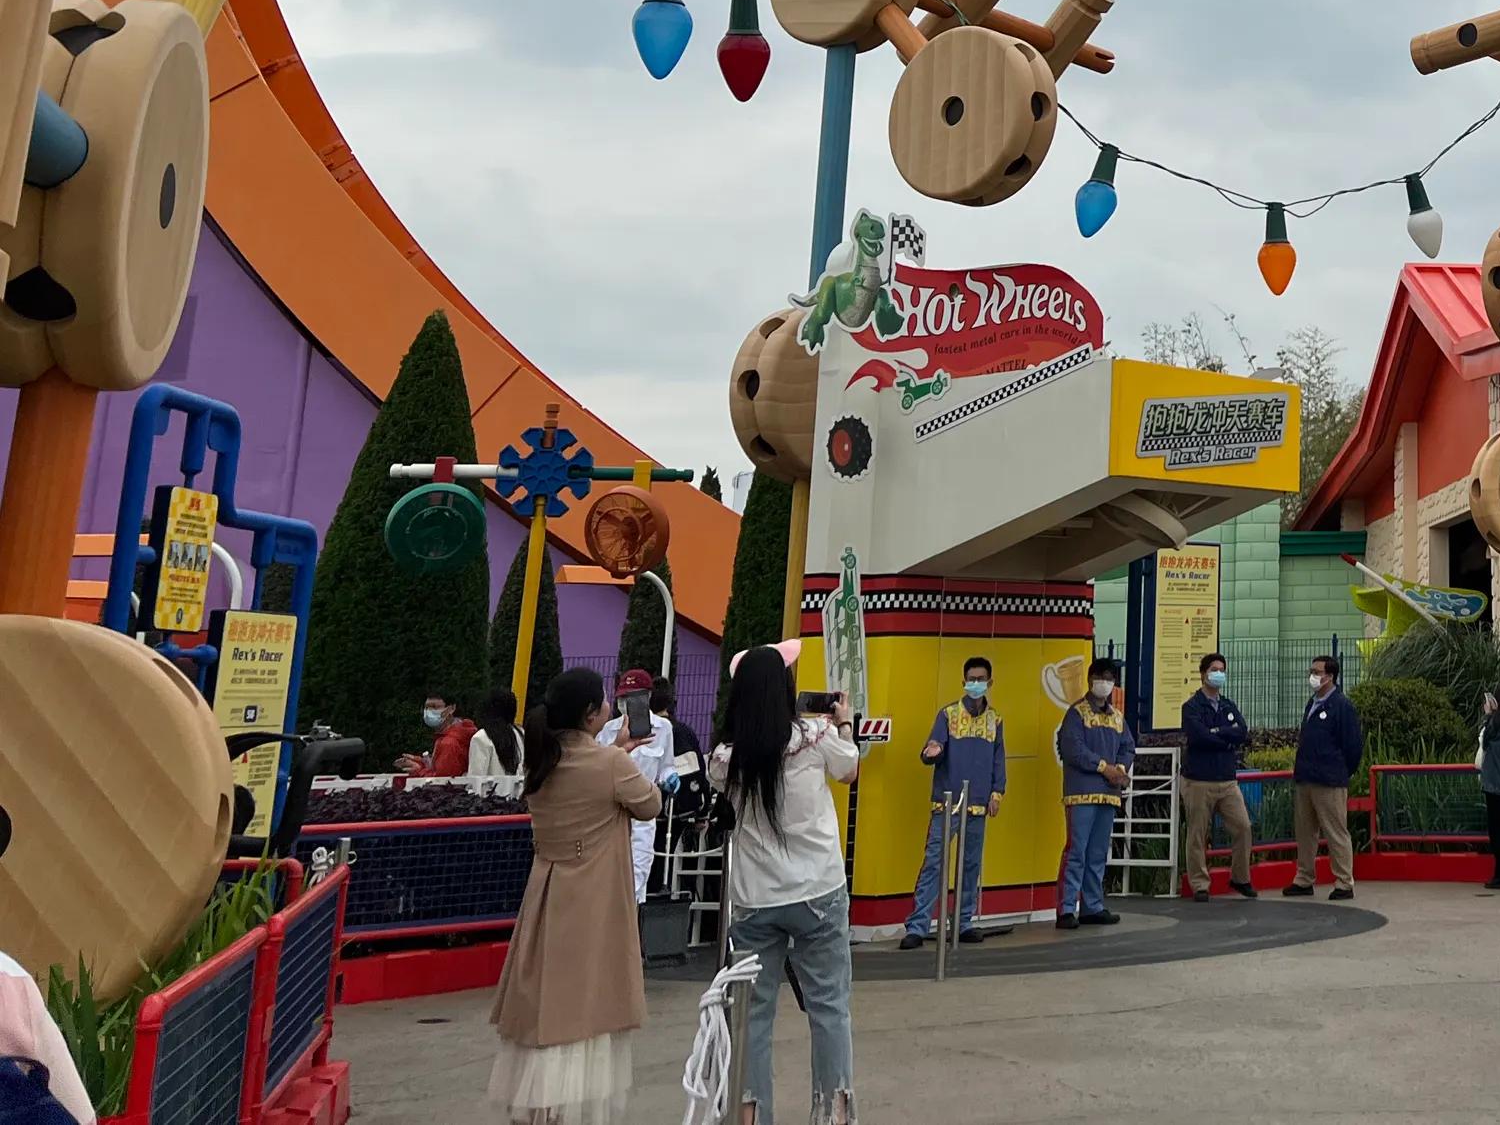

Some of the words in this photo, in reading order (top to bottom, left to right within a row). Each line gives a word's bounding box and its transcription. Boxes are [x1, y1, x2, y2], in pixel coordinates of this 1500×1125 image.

[890, 282, 967, 338] Hot
[965, 271, 1087, 333] Wheels
[934, 343, 967, 355] fastest
[970, 332, 997, 350] metal
[1000, 328, 1020, 340] cars
[1022, 324, 1031, 335] in
[1034, 324, 1049, 335] the
[1144, 398, 1286, 438] 抱抱龙冲天赛车
[1168, 448, 1212, 466] Rex's
[1213, 445, 1256, 462] Racer
[1165, 570, 1187, 579] Rex's
[1188, 571, 1210, 580] Racer
[232, 647, 257, 662] Rex's
[258, 648, 284, 663] Racer
